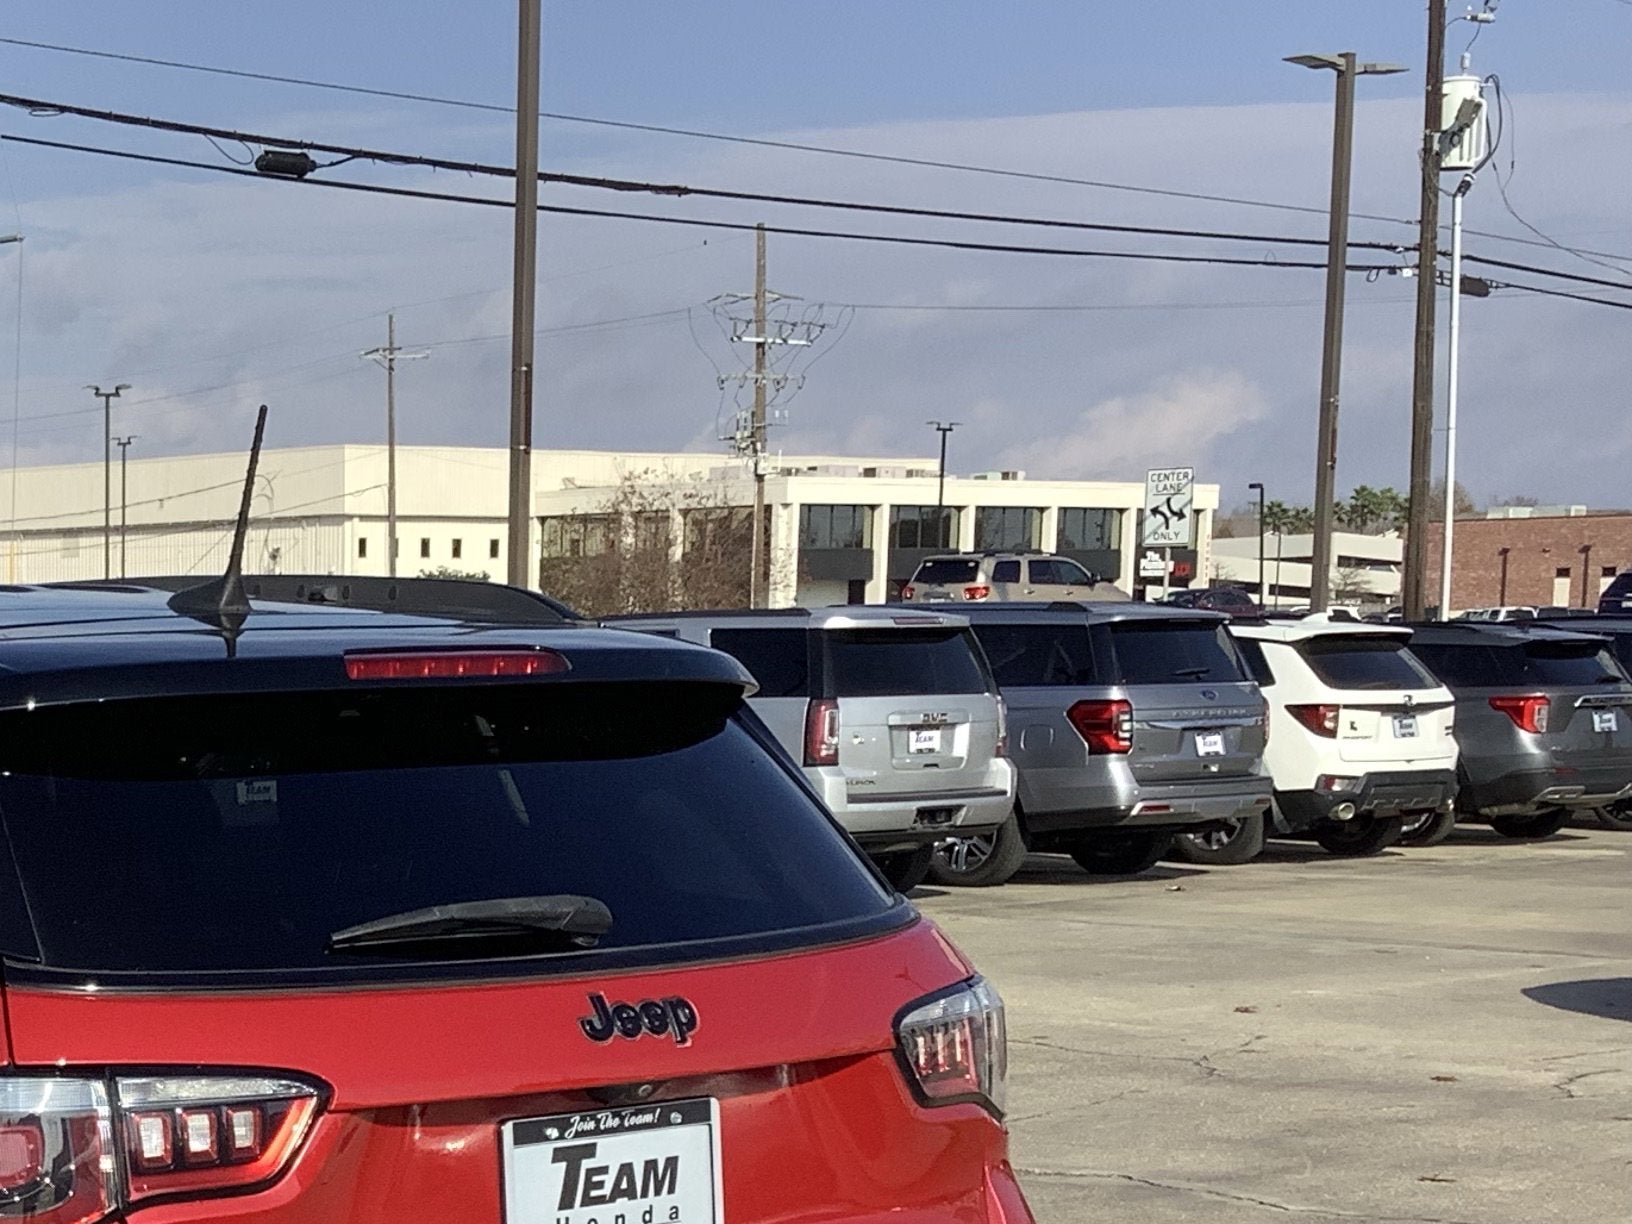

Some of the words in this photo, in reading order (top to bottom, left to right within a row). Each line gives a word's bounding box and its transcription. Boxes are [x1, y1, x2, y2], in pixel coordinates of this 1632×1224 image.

[1150, 471, 1189, 483] CENTER
[1155, 483, 1183, 493] LANE
[1152, 531, 1180, 541] ONLY
[578, 991, 699, 1047] Jeep
[564, 1115, 596, 1139] Join
[596, 1111, 621, 1131] The
[621, 1107, 661, 1127] Team!
[551, 1142, 680, 1212] TEAM
